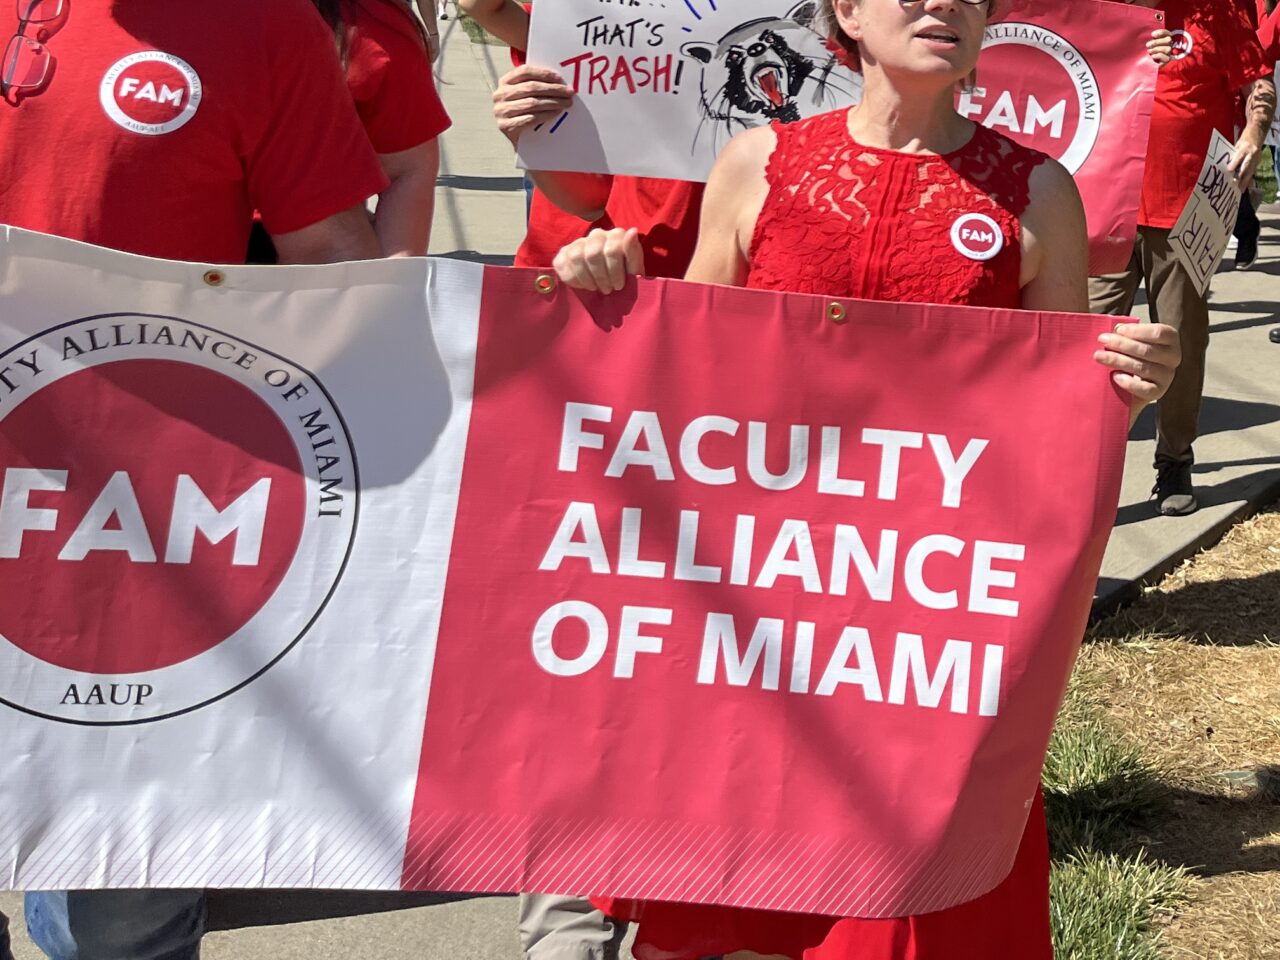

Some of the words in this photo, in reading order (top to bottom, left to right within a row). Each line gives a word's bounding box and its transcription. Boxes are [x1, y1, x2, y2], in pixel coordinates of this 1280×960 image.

[576, 16, 665, 48] THAT'S
[120, 78, 184, 107] FAM
[560, 51, 684, 95] TRASH!
[985, 26, 1060, 52] ALLIANCE
[1064, 50, 1081, 69] OF
[1077, 71, 1095, 121] MIAMI
[957, 87, 1066, 139] FAM
[962, 228, 993, 243] FAM
[1183, 212, 1219, 276] FAIR
[61, 323, 257, 370] ALLIANCE
[264, 369, 309, 402] OF
[299, 408, 344, 518] MIAMI
[558, 401, 990, 508] FACULTY
[0, 468, 272, 566] FAM
[538, 501, 1025, 617] ALLIANCE
[531, 600, 673, 679] OF
[697, 612, 1004, 717] MIAMI
[60, 683, 153, 706] AAUP
